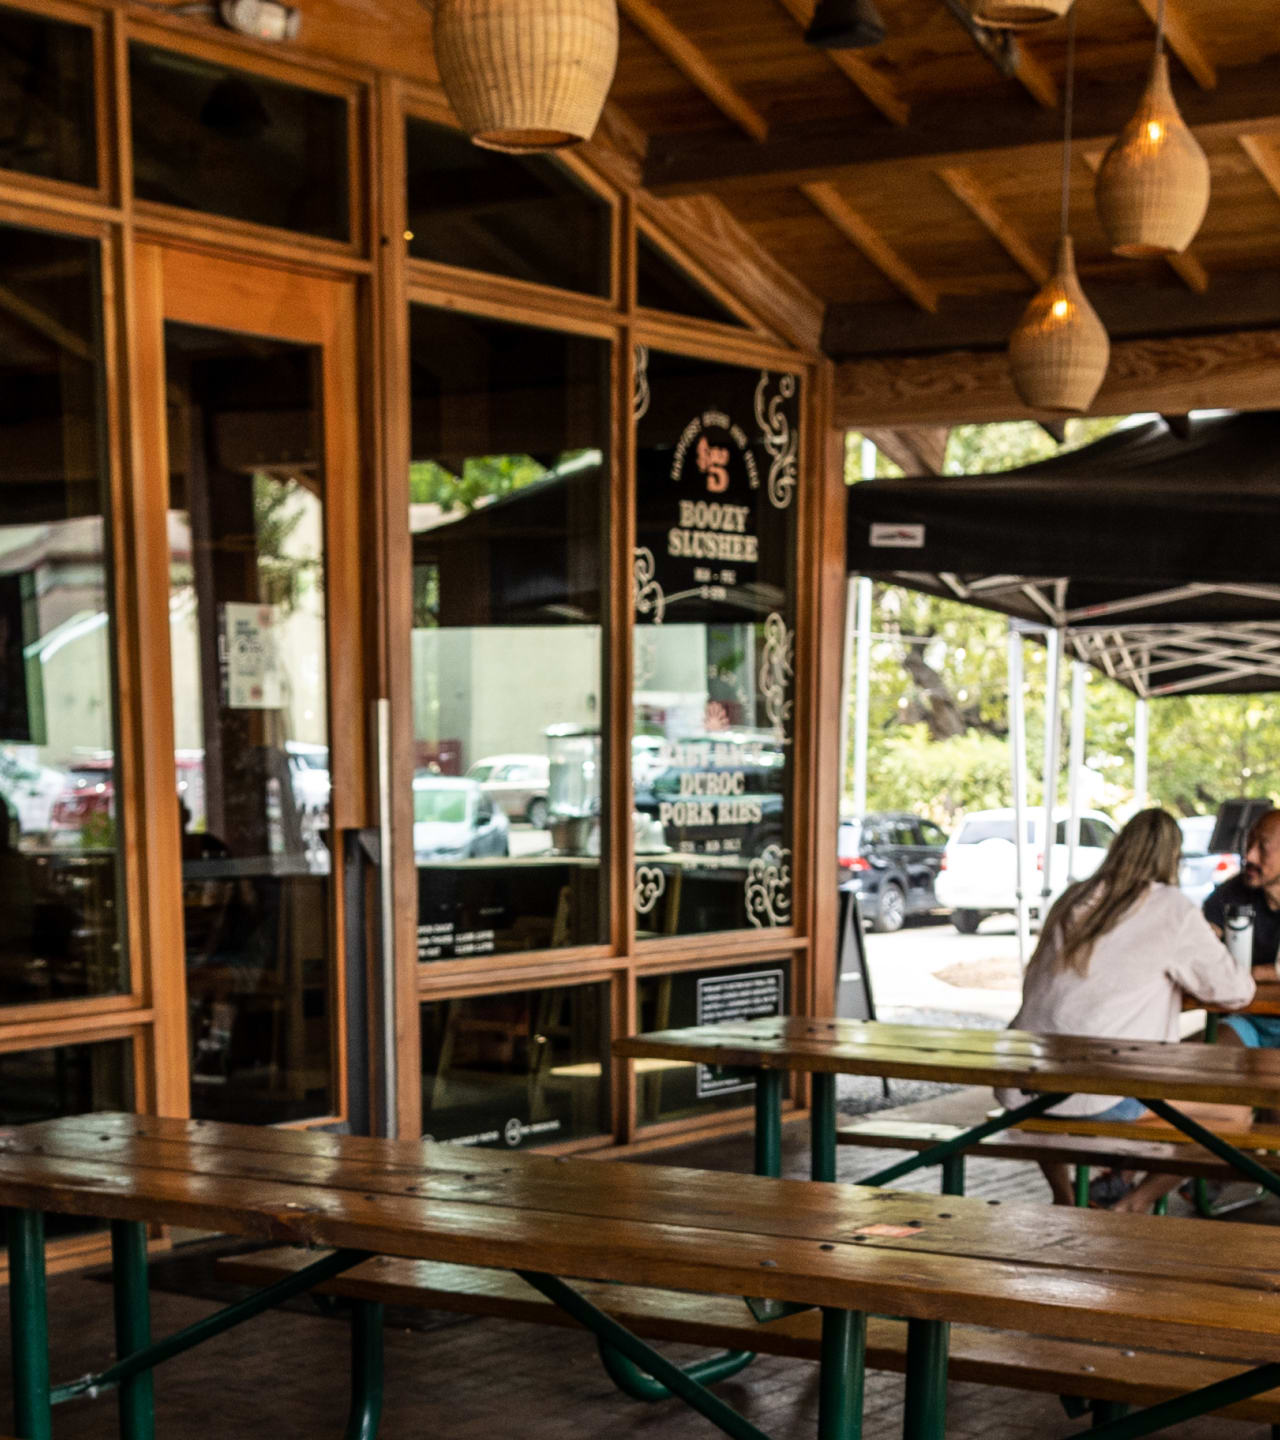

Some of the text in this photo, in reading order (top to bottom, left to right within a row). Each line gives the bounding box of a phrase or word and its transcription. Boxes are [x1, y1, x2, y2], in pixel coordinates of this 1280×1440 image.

[679, 500, 750, 532] BOOZY
[668, 528, 759, 562] SLUSHEE
[680, 771, 745, 795] DUROC
[659, 801, 762, 826] PORK RIBS
